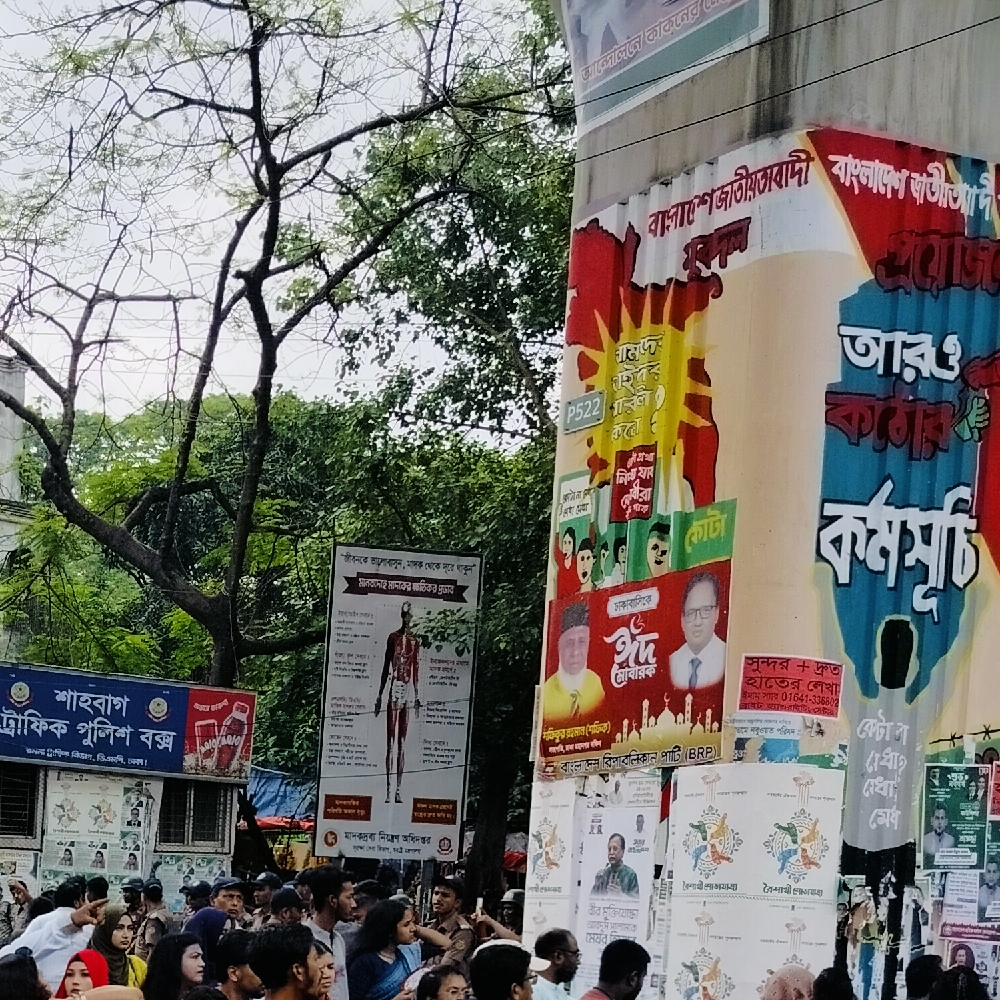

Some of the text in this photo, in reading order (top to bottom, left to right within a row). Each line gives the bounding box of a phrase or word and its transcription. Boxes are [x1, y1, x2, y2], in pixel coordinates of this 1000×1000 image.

[828, 154, 909, 199] বাংলাদেশ
[838, 324, 962, 384] আরও
[567, 397, 600, 424] P522
[825, 379, 955, 461] কঠোর
[685, 509, 727, 553] কোটা
[818, 473, 979, 625] কর্মসূচি
[407, 560, 423, 569] মাদক
[425, 561, 441, 570] থেকে
[603, 624, 659, 668] ঈদ
[611, 664, 658, 688] মোবারক
[745, 656, 842, 677] সুন্দর + দ্রুত
[745, 676, 840, 696] হাতের লেখা
[54, 688, 131, 717] শাহবাগ
[76, 716, 134, 748] পুলিশ
[139, 728, 177, 752] বক্স
[560, 757, 600, 774] বাংলাদেশ
[602, 749, 657, 770] রিপাবলিকান
[661, 744, 682, 765] পার্টি
[684, 745, 717, 763] (BRP)
[345, 830, 431, 845] মাদকদ্রব্য নিয়ন্ত্রণ অধিদপ্তর
[682, 880, 703, 892] বৈশাখী
[763, 882, 791, 895] বৈশাখী
[588, 903, 601, 916] বীর
